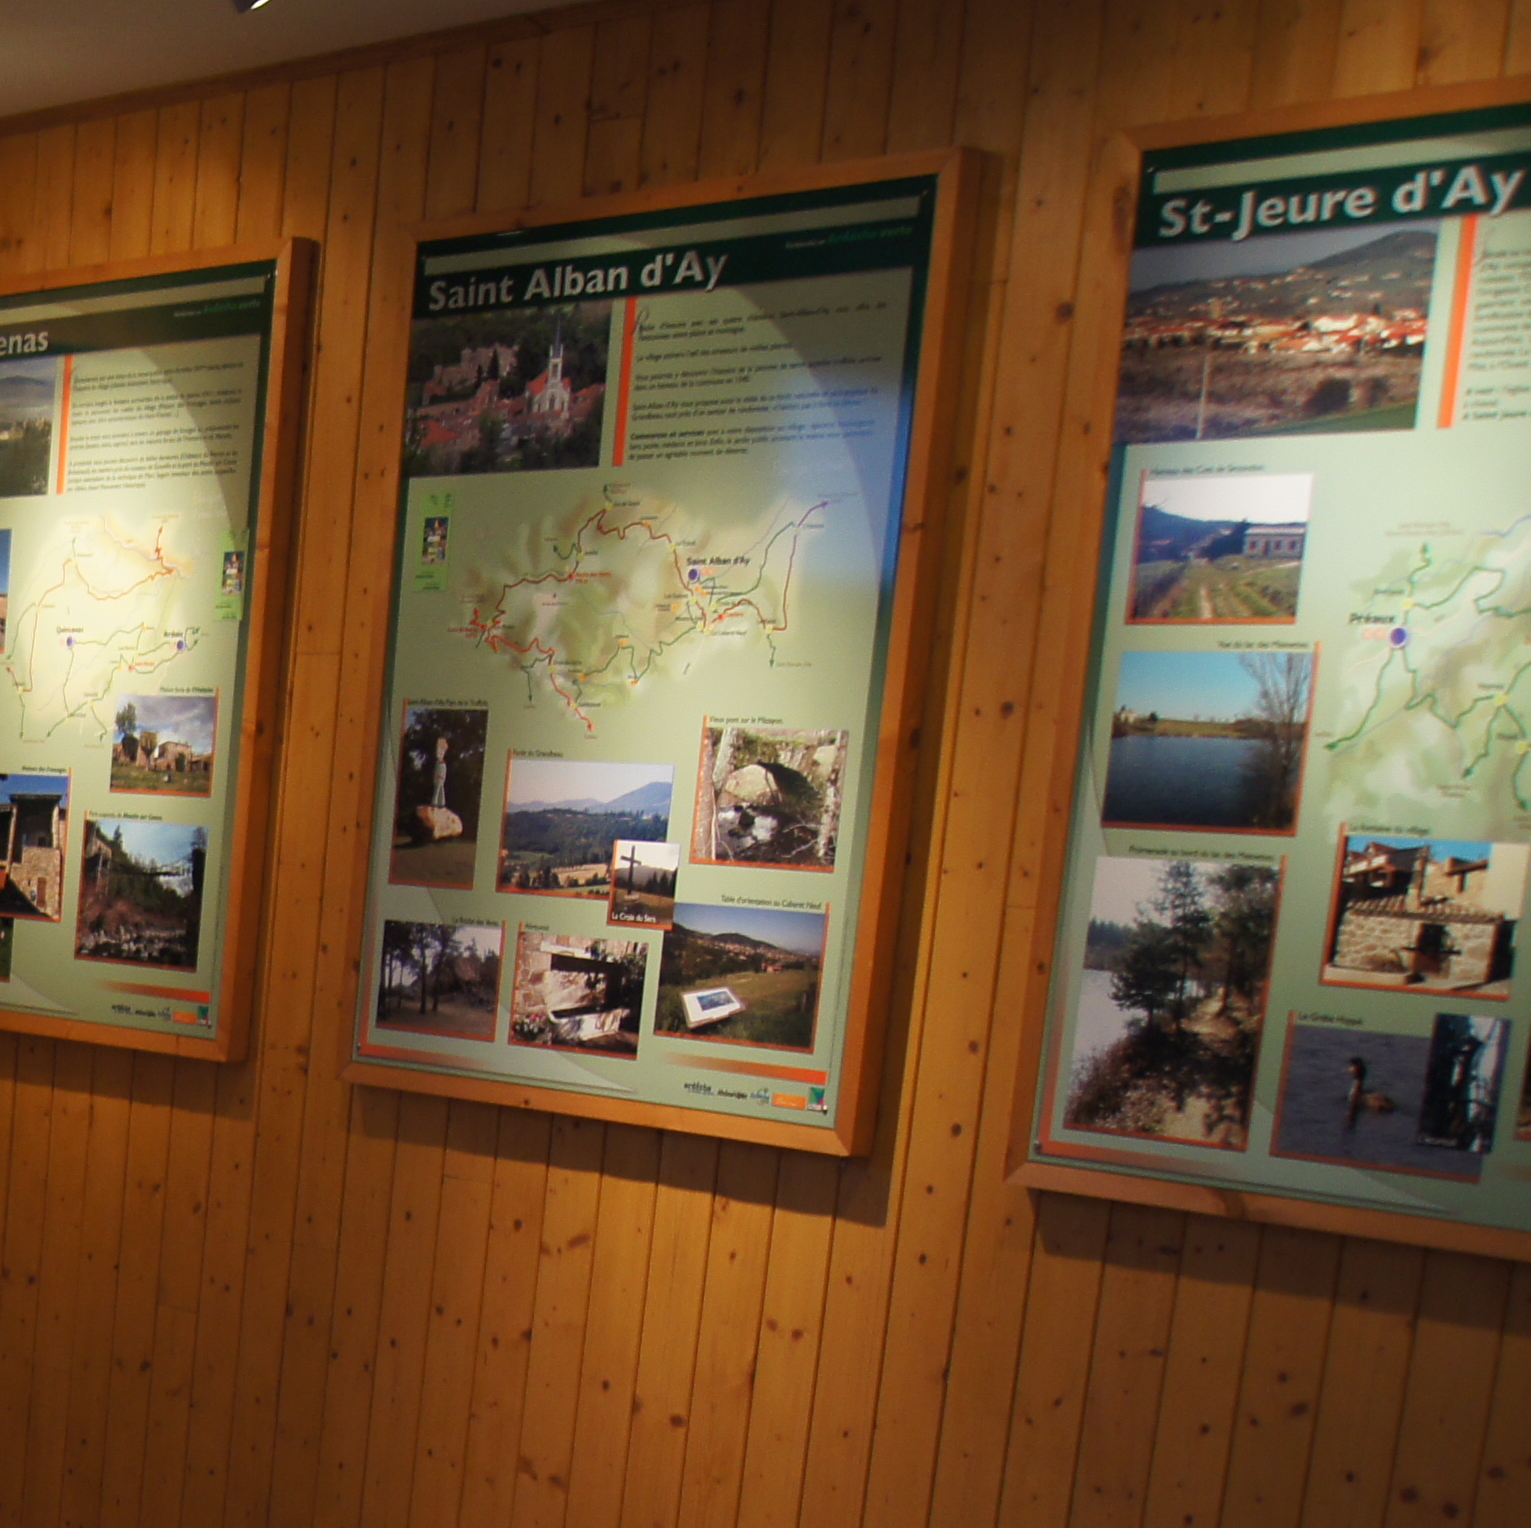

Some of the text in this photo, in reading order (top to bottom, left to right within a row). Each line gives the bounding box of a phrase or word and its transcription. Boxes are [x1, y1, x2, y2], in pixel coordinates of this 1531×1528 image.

[1159, 164, 1528, 241] St-Jeure d'Ay
[427, 251, 728, 311] Saint Alban d'Ay
